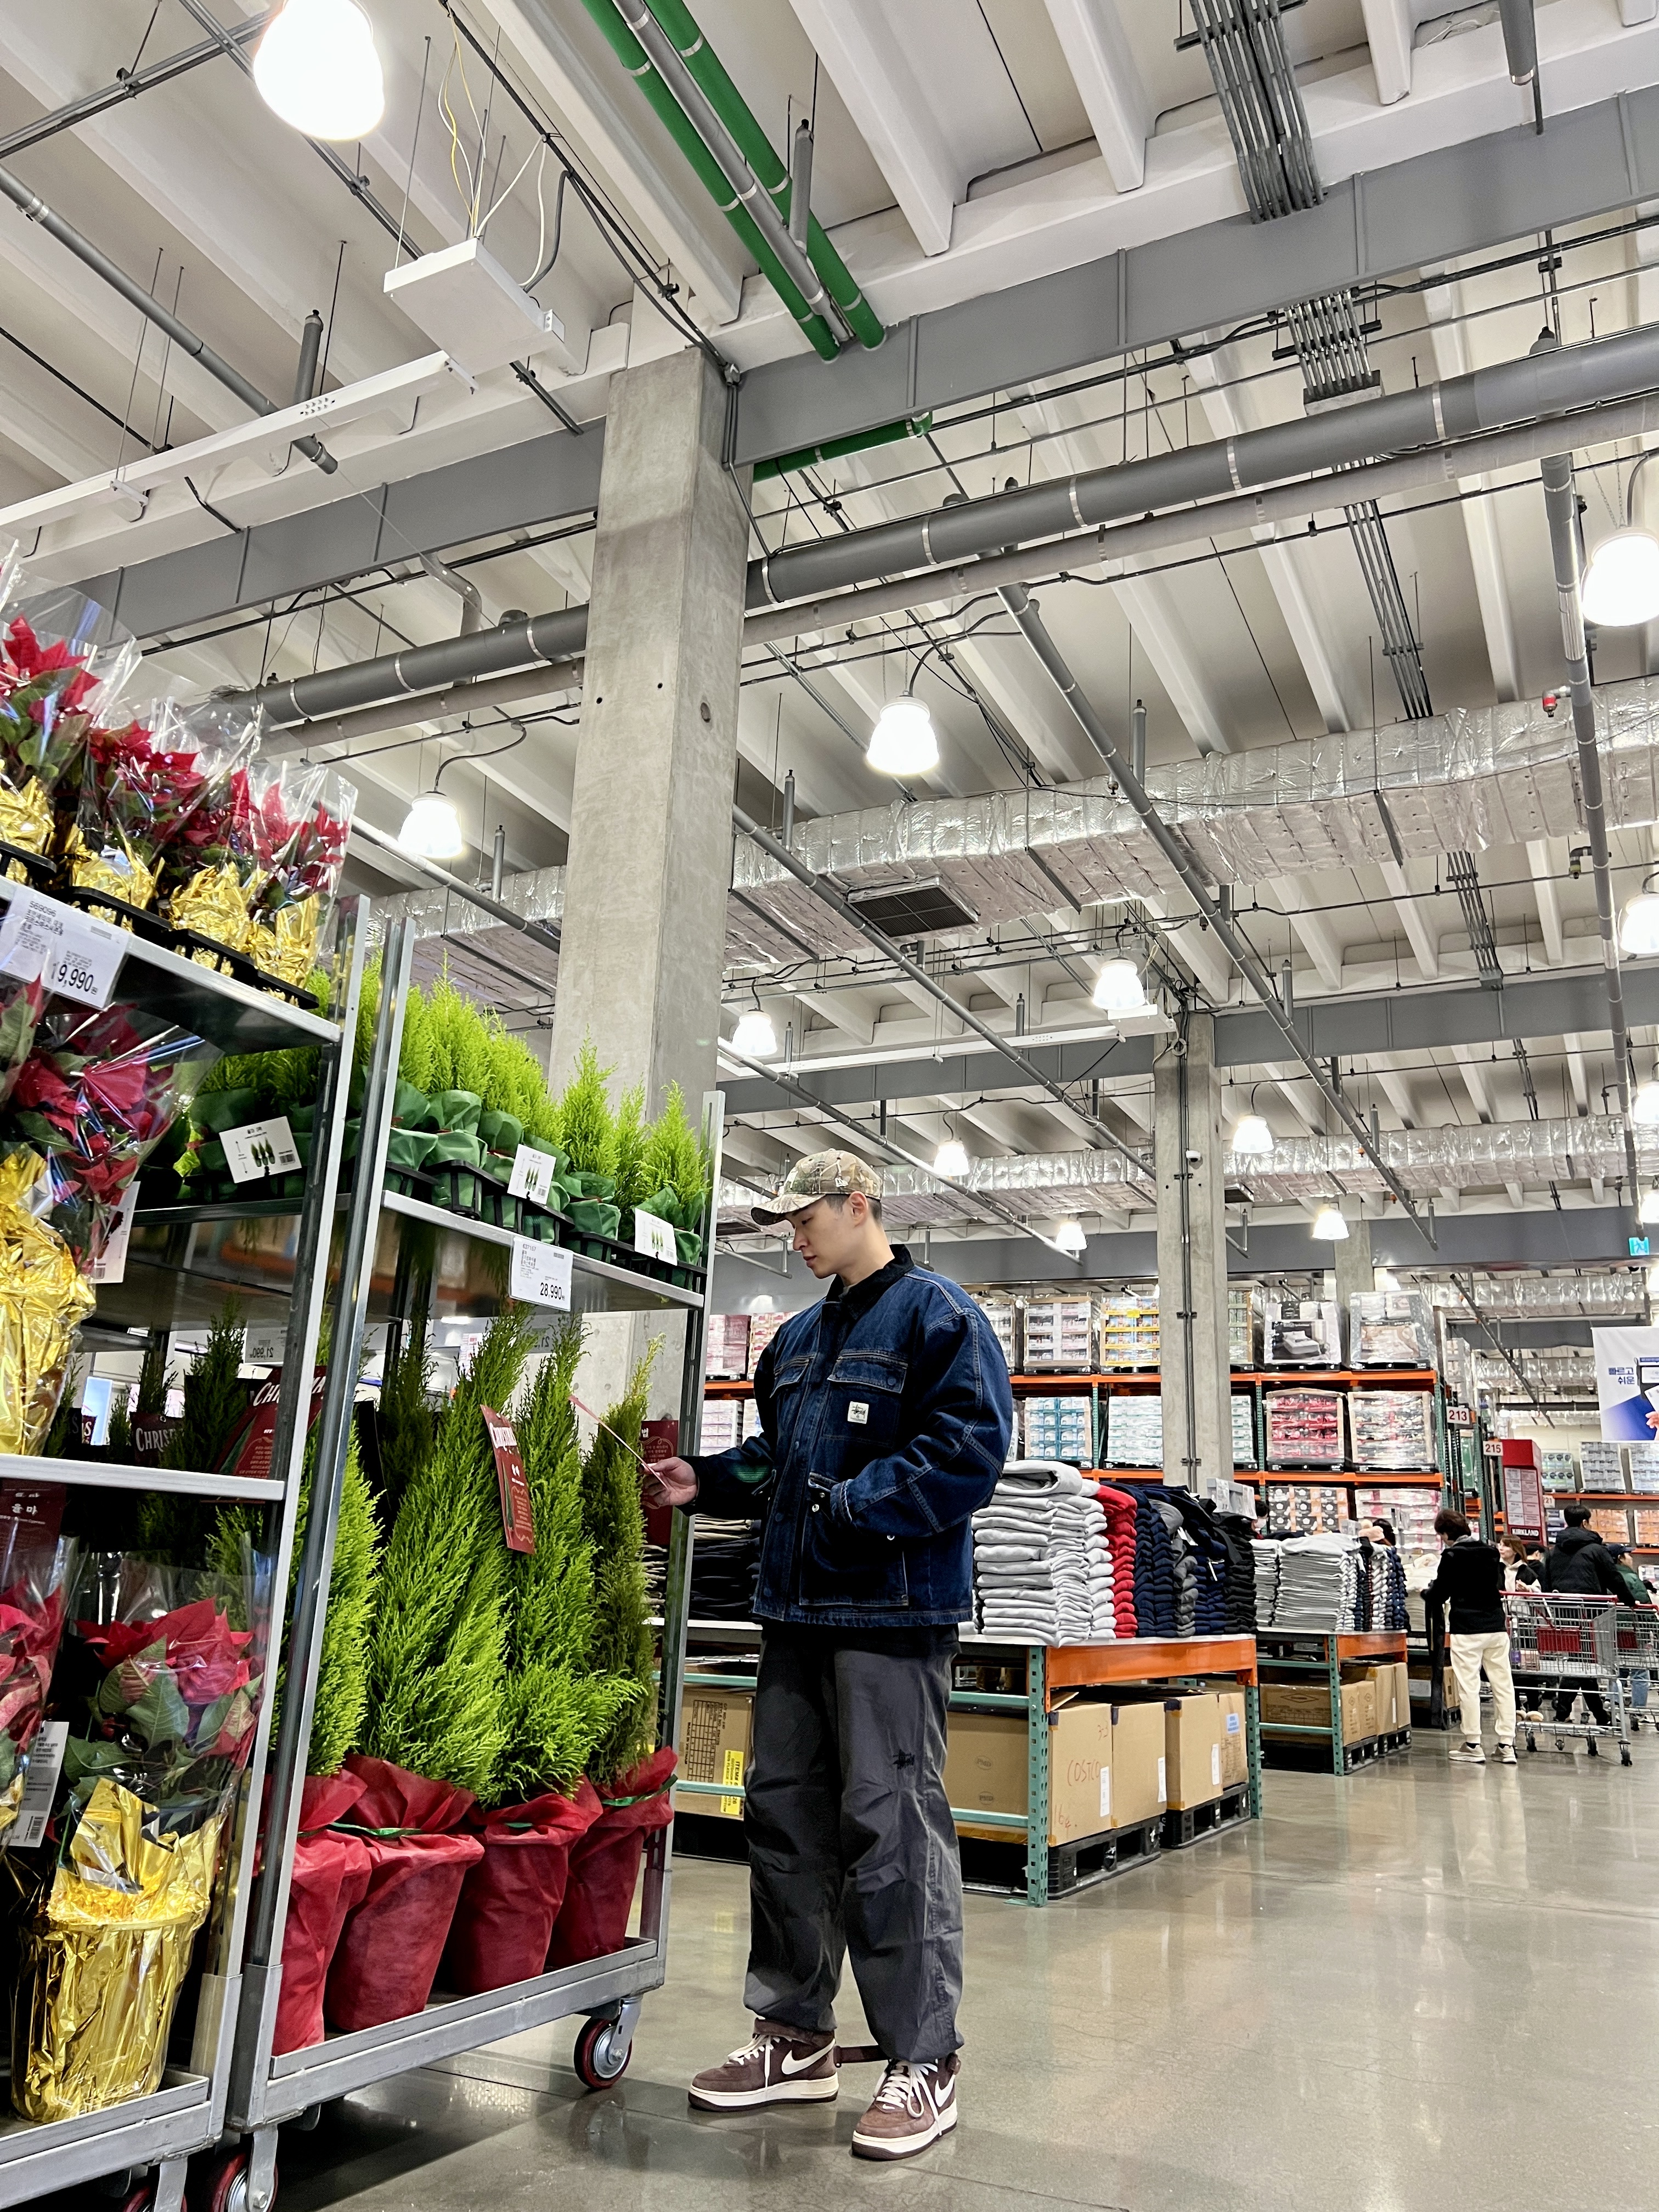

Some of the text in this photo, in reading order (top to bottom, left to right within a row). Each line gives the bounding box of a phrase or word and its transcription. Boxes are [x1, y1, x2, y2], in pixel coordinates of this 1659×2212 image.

[29, 900, 57, 917] 569096
[1608, 1367, 1634, 1375] 빠르고
[1618, 1376, 1635, 1385] 쉬운
[1448, 1409, 1468, 1421] 213
[1485, 1443, 1502, 1454] 215
[1512, 1528, 1539, 1537] KIRKLAND
